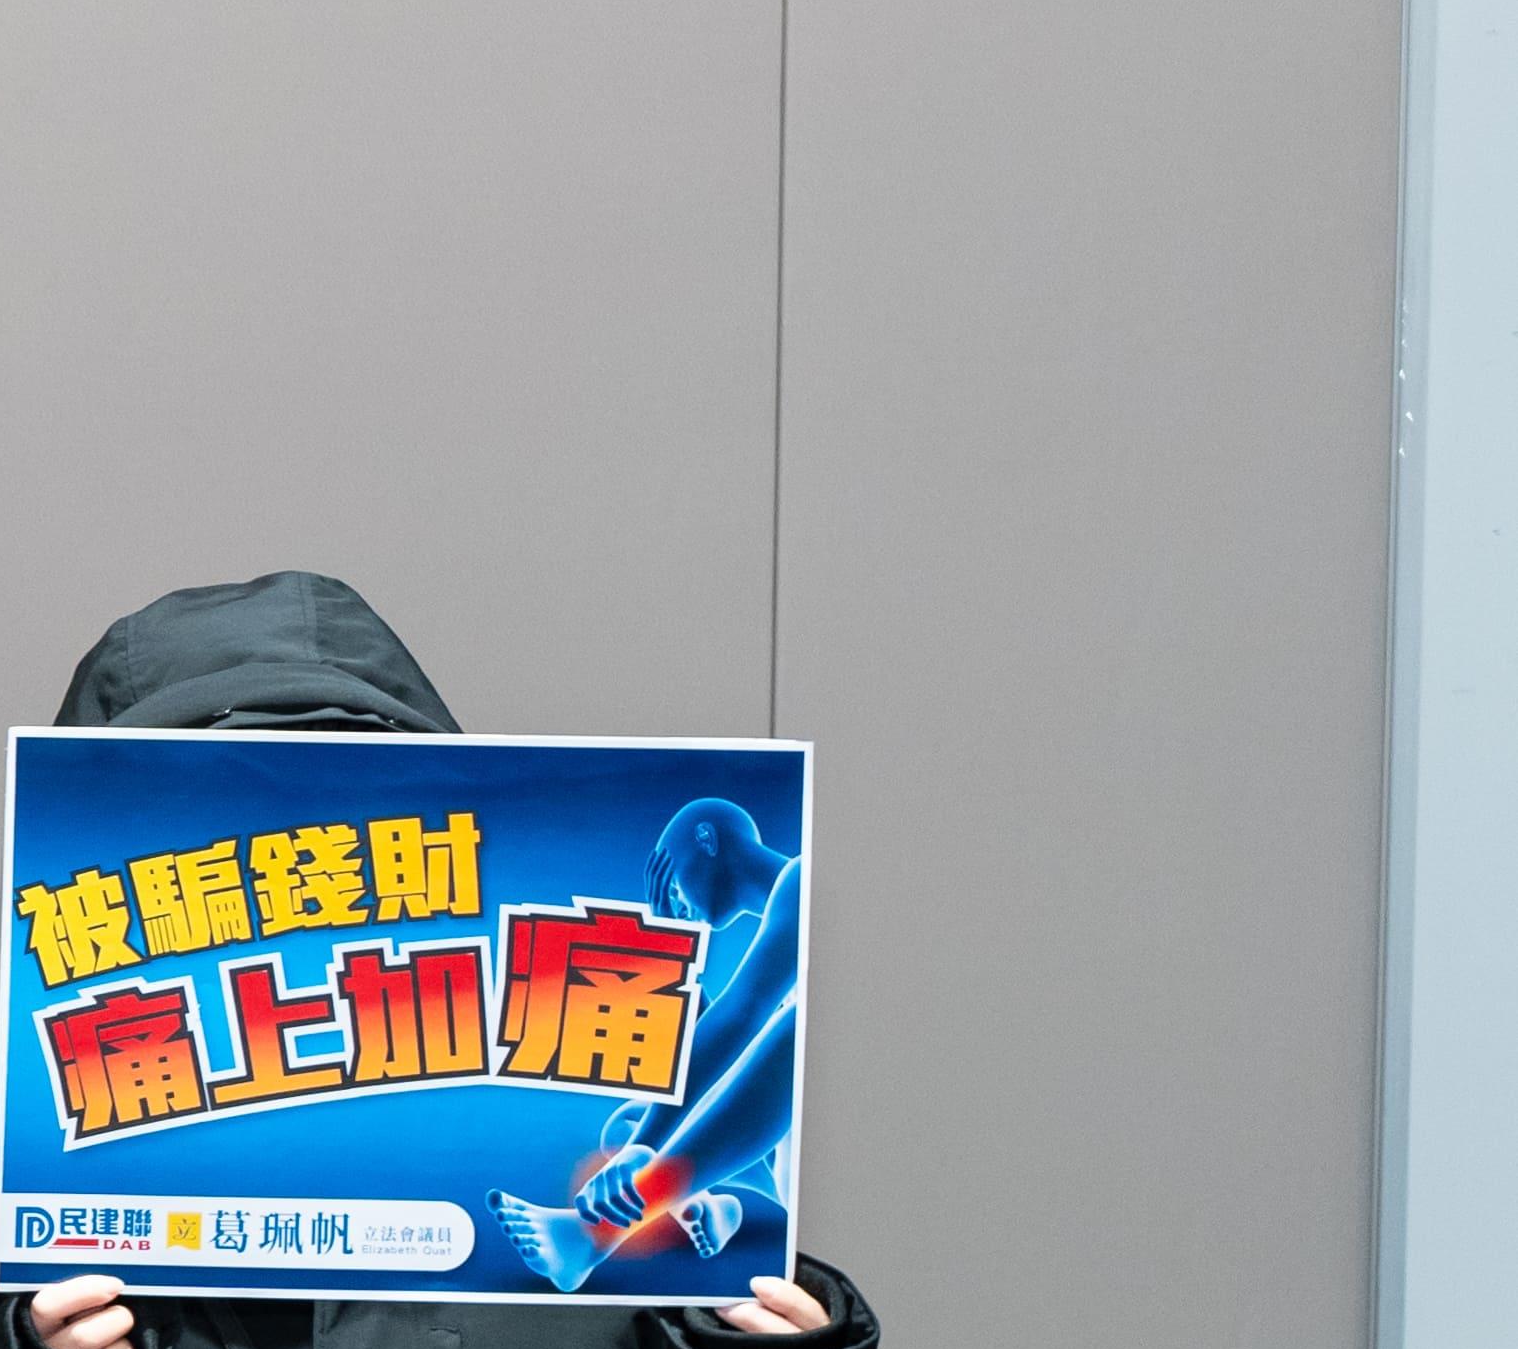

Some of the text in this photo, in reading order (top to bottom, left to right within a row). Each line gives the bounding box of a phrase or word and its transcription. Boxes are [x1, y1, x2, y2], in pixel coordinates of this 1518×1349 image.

[18, 812, 482, 985] 被騙錢財
[49, 908, 694, 1134] 痛上加痛
[59, 1208, 152, 1236] 民建聯
[210, 1210, 353, 1254] 葛珮帆
[364, 1225, 452, 1243] 立法會議員
[104, 1240, 150, 1250] DAB
[362, 1245, 452, 1256] Elizabeth Quat
